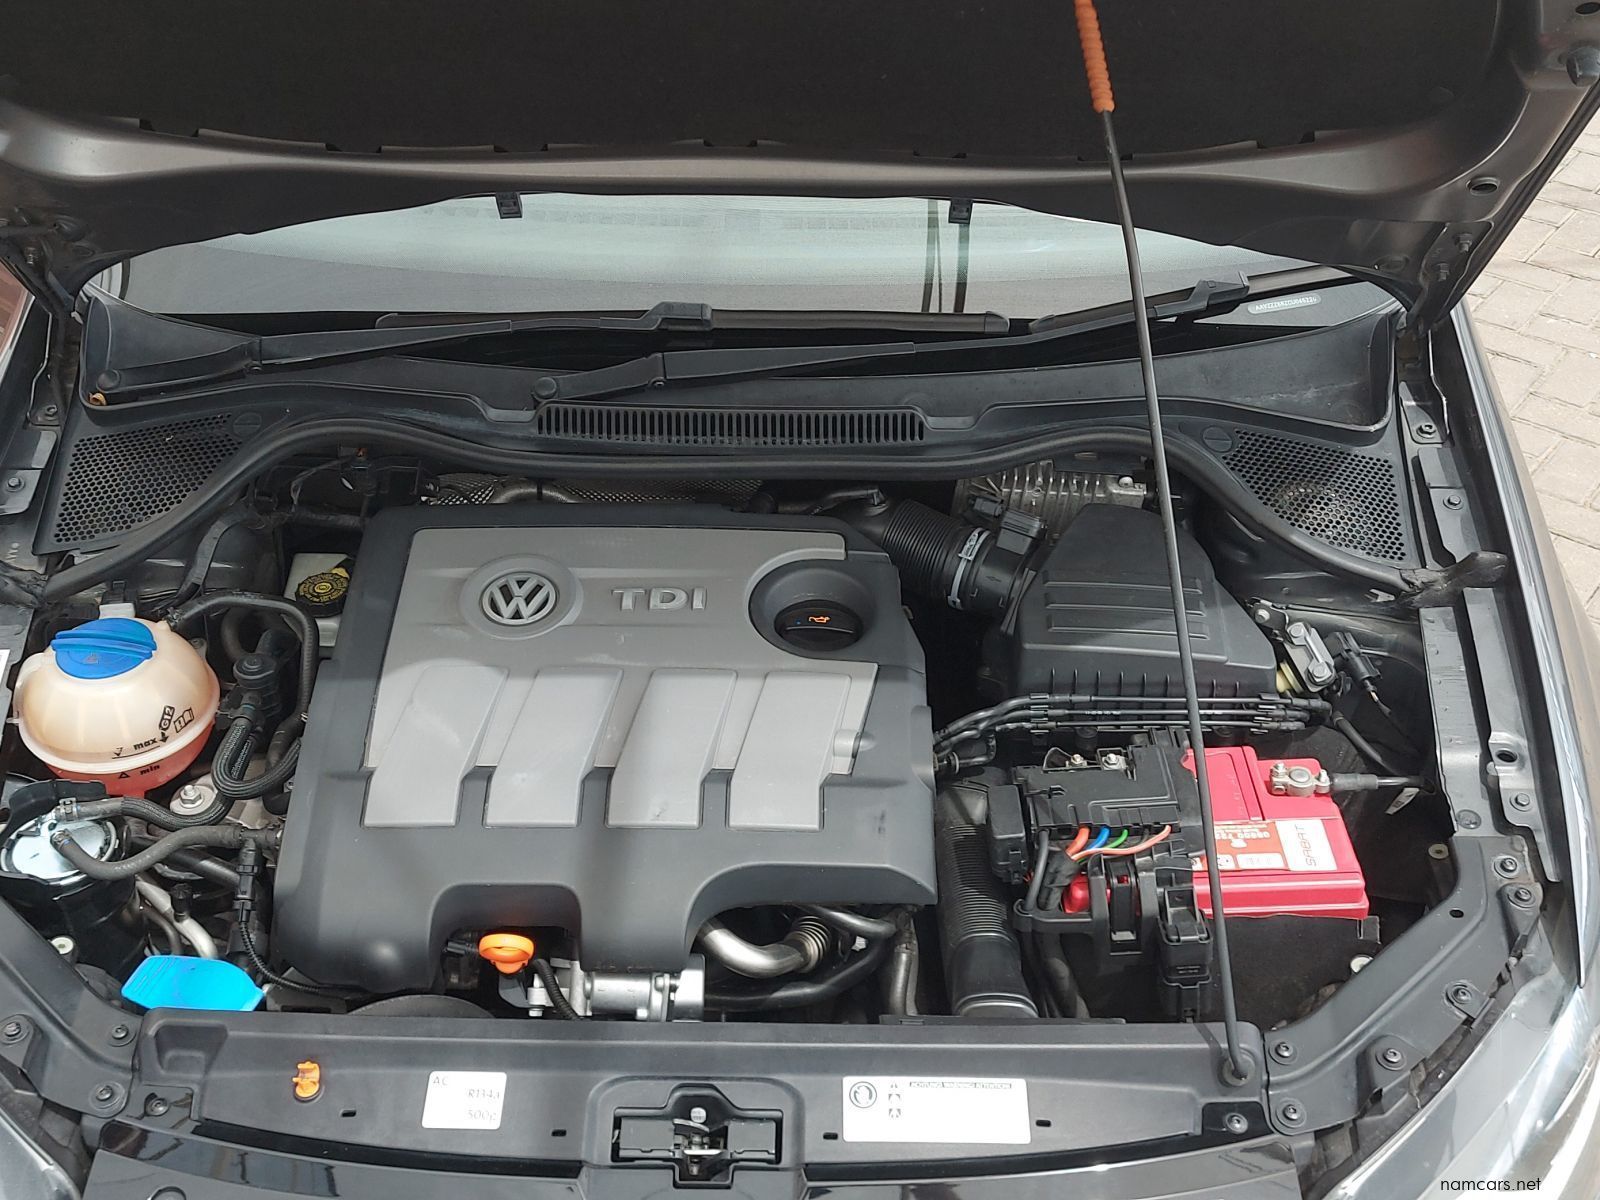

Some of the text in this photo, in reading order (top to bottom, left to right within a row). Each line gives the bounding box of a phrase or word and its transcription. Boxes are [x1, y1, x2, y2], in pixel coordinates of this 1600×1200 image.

[611, 587, 708, 611] TDI
[133, 737, 158, 751] max
[139, 764, 161, 776] min
[1294, 824, 1318, 867] SABAT
